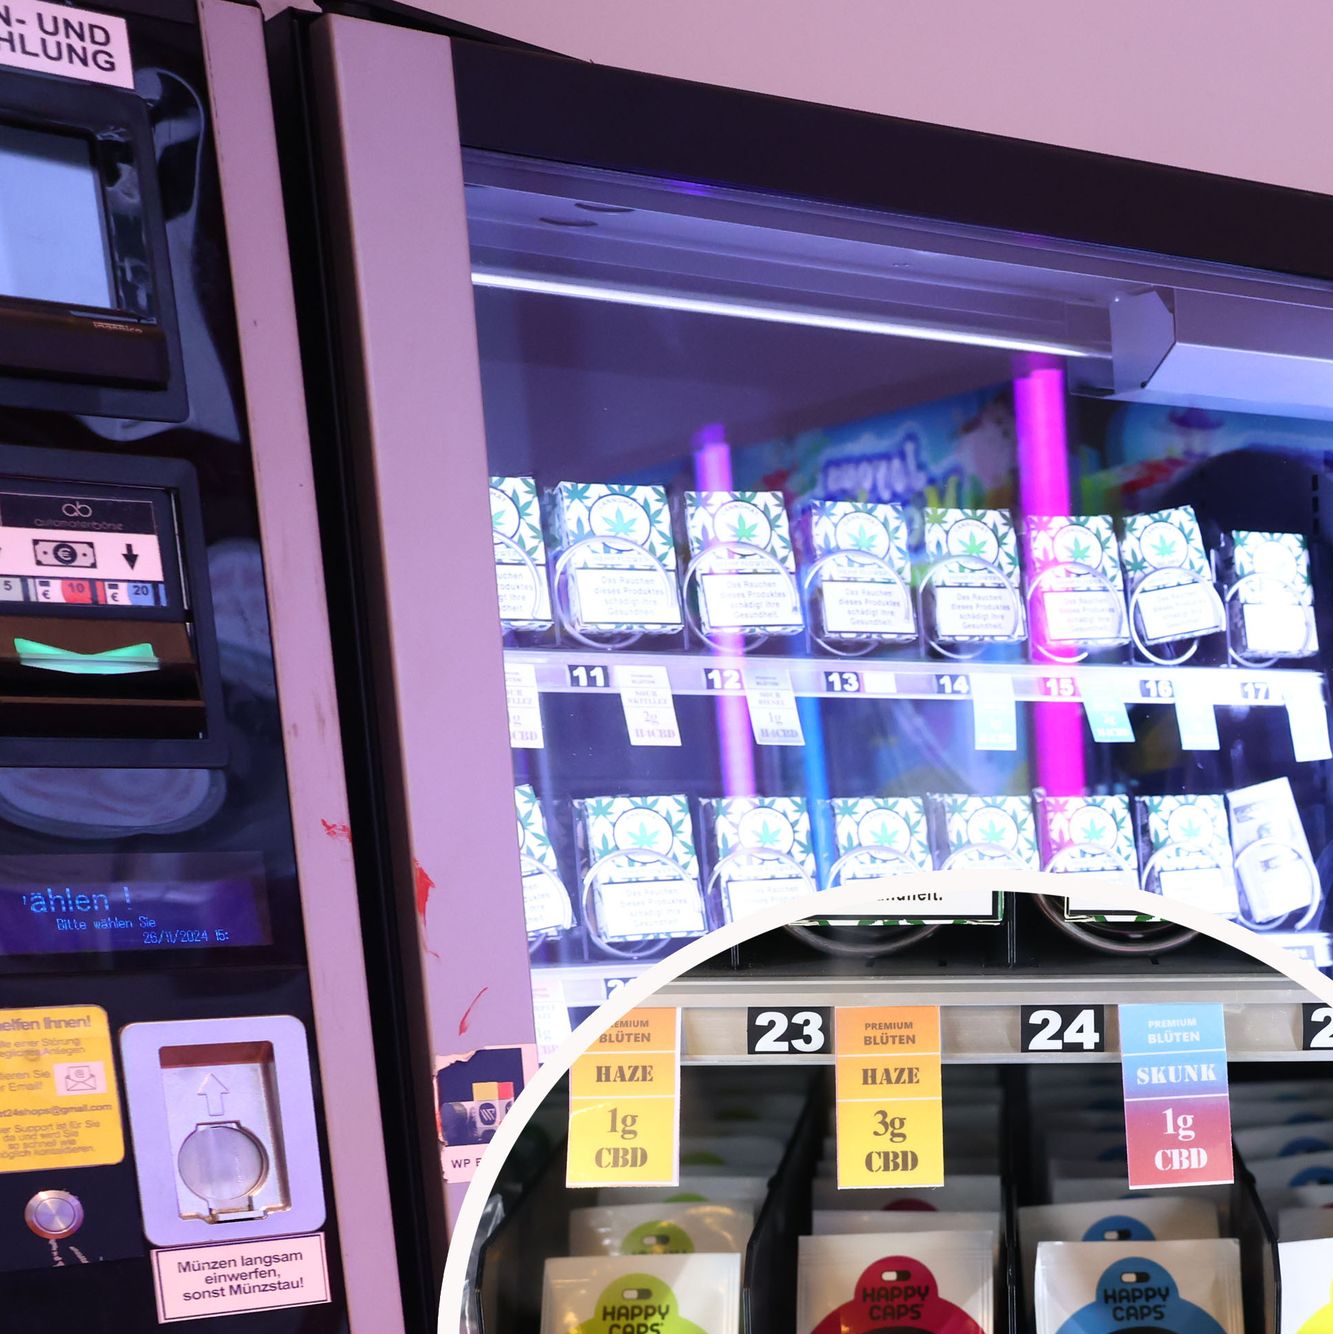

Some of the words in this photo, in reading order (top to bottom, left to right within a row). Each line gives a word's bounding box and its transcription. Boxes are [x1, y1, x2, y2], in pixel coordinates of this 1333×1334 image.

[37, 12, 111, 46] UND
[67, 582, 86, 594] 10
[132, 585, 150, 597] 20
[573, 667, 604, 686] 11
[708, 669, 741, 689] 12
[829, 672, 859, 691] 13
[940, 675, 969, 693] 14
[1046, 677, 1075, 697] 15
[1146, 680, 1173, 699] 16
[1243, 682, 1270, 700] 17
[22, 886, 110, 913] ählen
[56, 918, 87, 930] Bitte
[93, 917, 133, 930] wählen
[138, 915, 157, 928] Sie
[754, 1011, 825, 1053] 23
[864, 1021, 913, 1032] PREMIUM
[1027, 1009, 1100, 1051] 24
[1147, 1017, 1197, 1030] PREMIUM
[599, 1030, 651, 1044] BLÜTEN
[863, 1031, 916, 1047] BLÜTEN
[1147, 1028, 1201, 1045] BLÜTEN
[595, 1065, 654, 1084] HAZE
[861, 1067, 920, 1087] HAZE
[1136, 1064, 1217, 1086] SKUNK
[607, 1107, 638, 1141] 1g
[872, 1109, 908, 1145] 3g
[1162, 1107, 1195, 1141] 1g
[594, 1146, 648, 1170] CBD
[864, 1149, 919, 1174] CBD
[1153, 1147, 1208, 1171] CBD
[178, 1257, 237, 1274] Münzen
[241, 1251, 303, 1268] langsam
[204, 1268, 282, 1285] einwerfen,
[182, 1286, 227, 1301] sonst
[229, 1277, 304, 1297] Münzstau!
[862, 1285, 929, 1303] HAPPY
[1103, 1287, 1170, 1304] HAPPY
[602, 1305, 669, 1322] HAPPY
[869, 1302, 923, 1321] CAPS
[1112, 1303, 1166, 1321] CAPS
